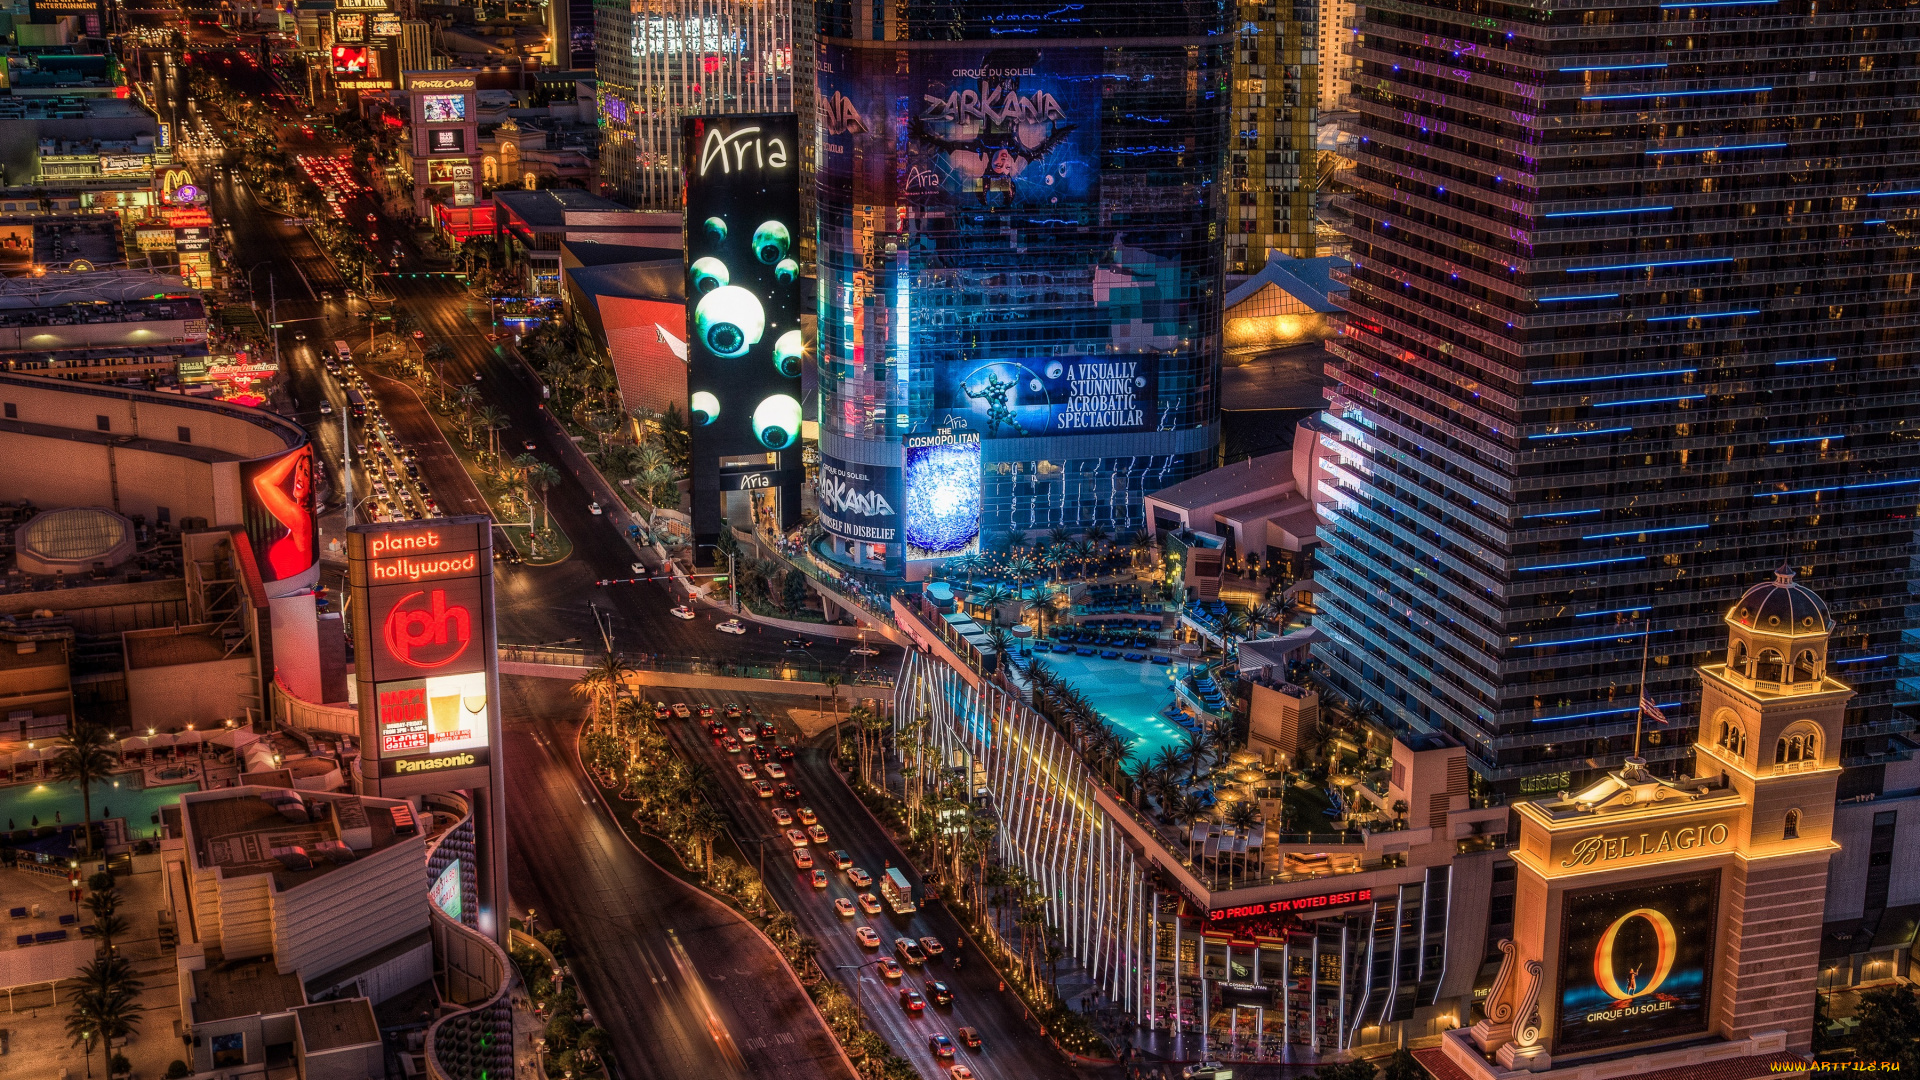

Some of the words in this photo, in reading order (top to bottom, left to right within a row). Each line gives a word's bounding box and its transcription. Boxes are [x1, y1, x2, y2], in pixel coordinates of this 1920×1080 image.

[952, 69, 986, 79] CIRQUE
[989, 68, 1002, 77] DU
[1004, 68, 1036, 76] SOLEIL
[377, 81, 393, 89] PUB
[411, 80, 443, 89] Monte
[444, 79, 475, 89] Carlo
[919, 80, 1066, 129] ZARKANA
[701, 126, 787, 176] Aria
[905, 166, 939, 191] Aria
[1066, 364, 1075, 381] A
[1078, 362, 1138, 380] VISUALLY
[1070, 378, 1132, 397] STUNNING
[1066, 394, 1136, 413] ACROBATIC
[943, 414, 968, 430] Aria
[1057, 410, 1144, 429] SPECTACULAR
[909, 433, 980, 448] COSMOPOLITAN
[740, 473, 769, 490] Aria
[837, 469, 846, 477] DU
[847, 472, 870, 481] SOLEIL
[844, 523, 852, 535] IN
[853, 525, 896, 540] DISBELIEF
[372, 531, 439, 557] planet
[373, 553, 475, 580] hollywood
[395, 589, 471, 660] ph
[380, 687, 425, 706] HAPPY
[381, 703, 427, 724] HOUR
[395, 753, 475, 773] Panasonic
[1561, 823, 1729, 868] BELLAGIO
[1210, 910, 1224, 921] SO
[1227, 904, 1267, 919] PROUD.
[1269, 900, 1291, 912] STK
[1293, 895, 1327, 909] VOTED
[1329, 891, 1357, 904] BEST
[1593, 908, 1677, 1000] O
[1474, 988, 1488, 997] THE
[1587, 1009, 1623, 1023] CIRQUE
[1625, 1006, 1639, 1016] DU
